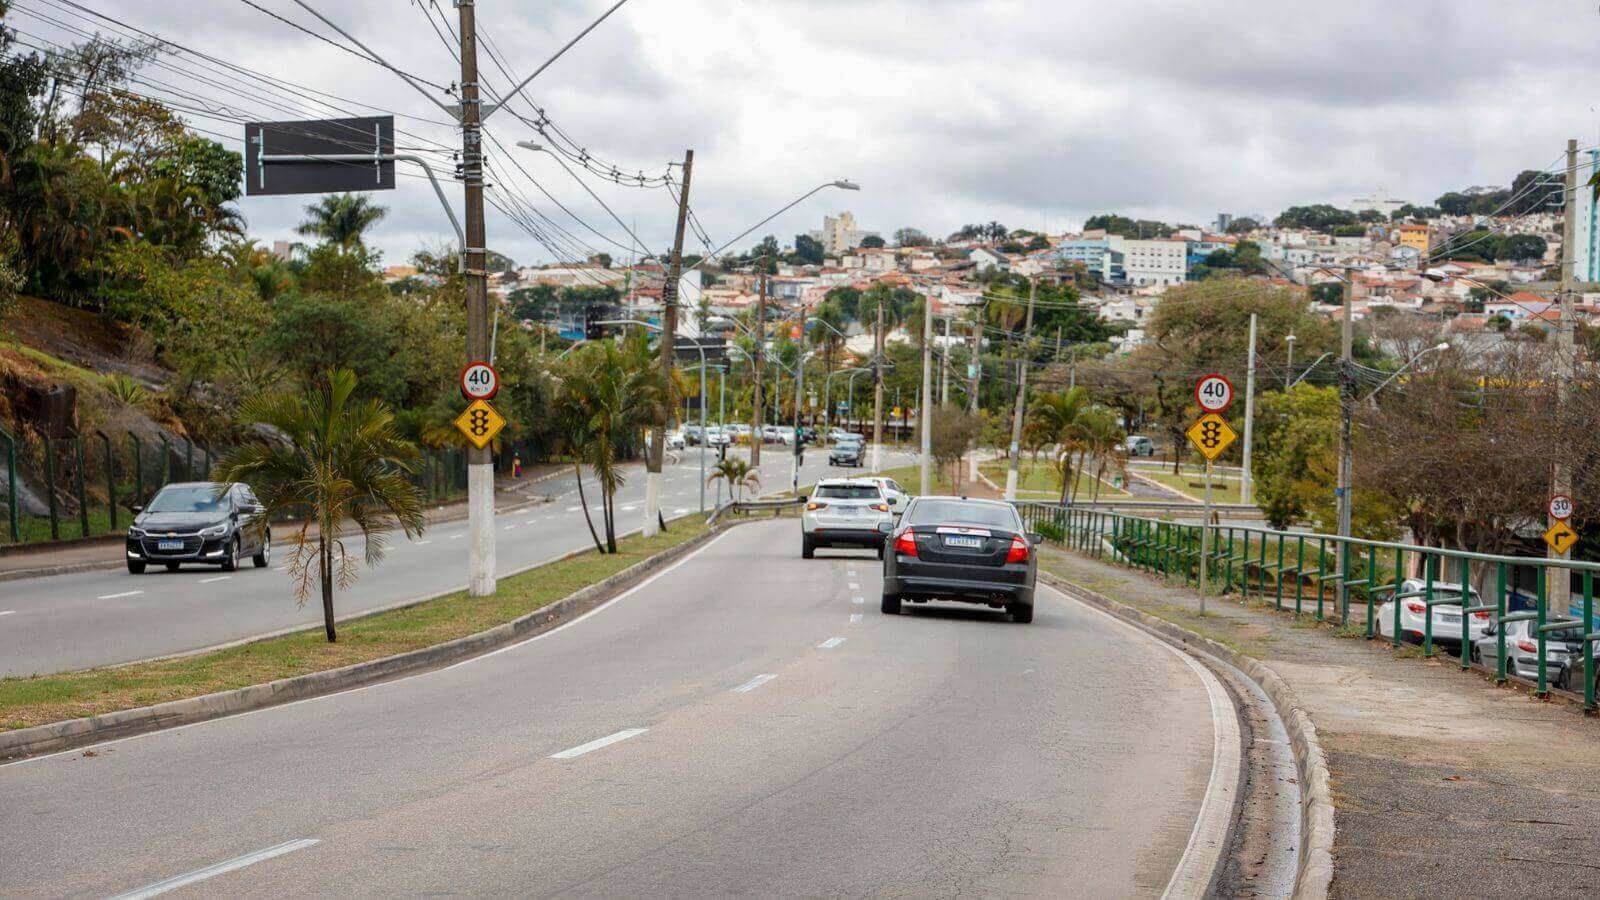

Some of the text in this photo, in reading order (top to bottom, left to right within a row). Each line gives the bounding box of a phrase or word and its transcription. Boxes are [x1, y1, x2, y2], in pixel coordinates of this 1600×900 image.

[469, 370, 490, 384] 40
[1203, 382, 1225, 398] 40
[1553, 500, 1568, 510] 30
